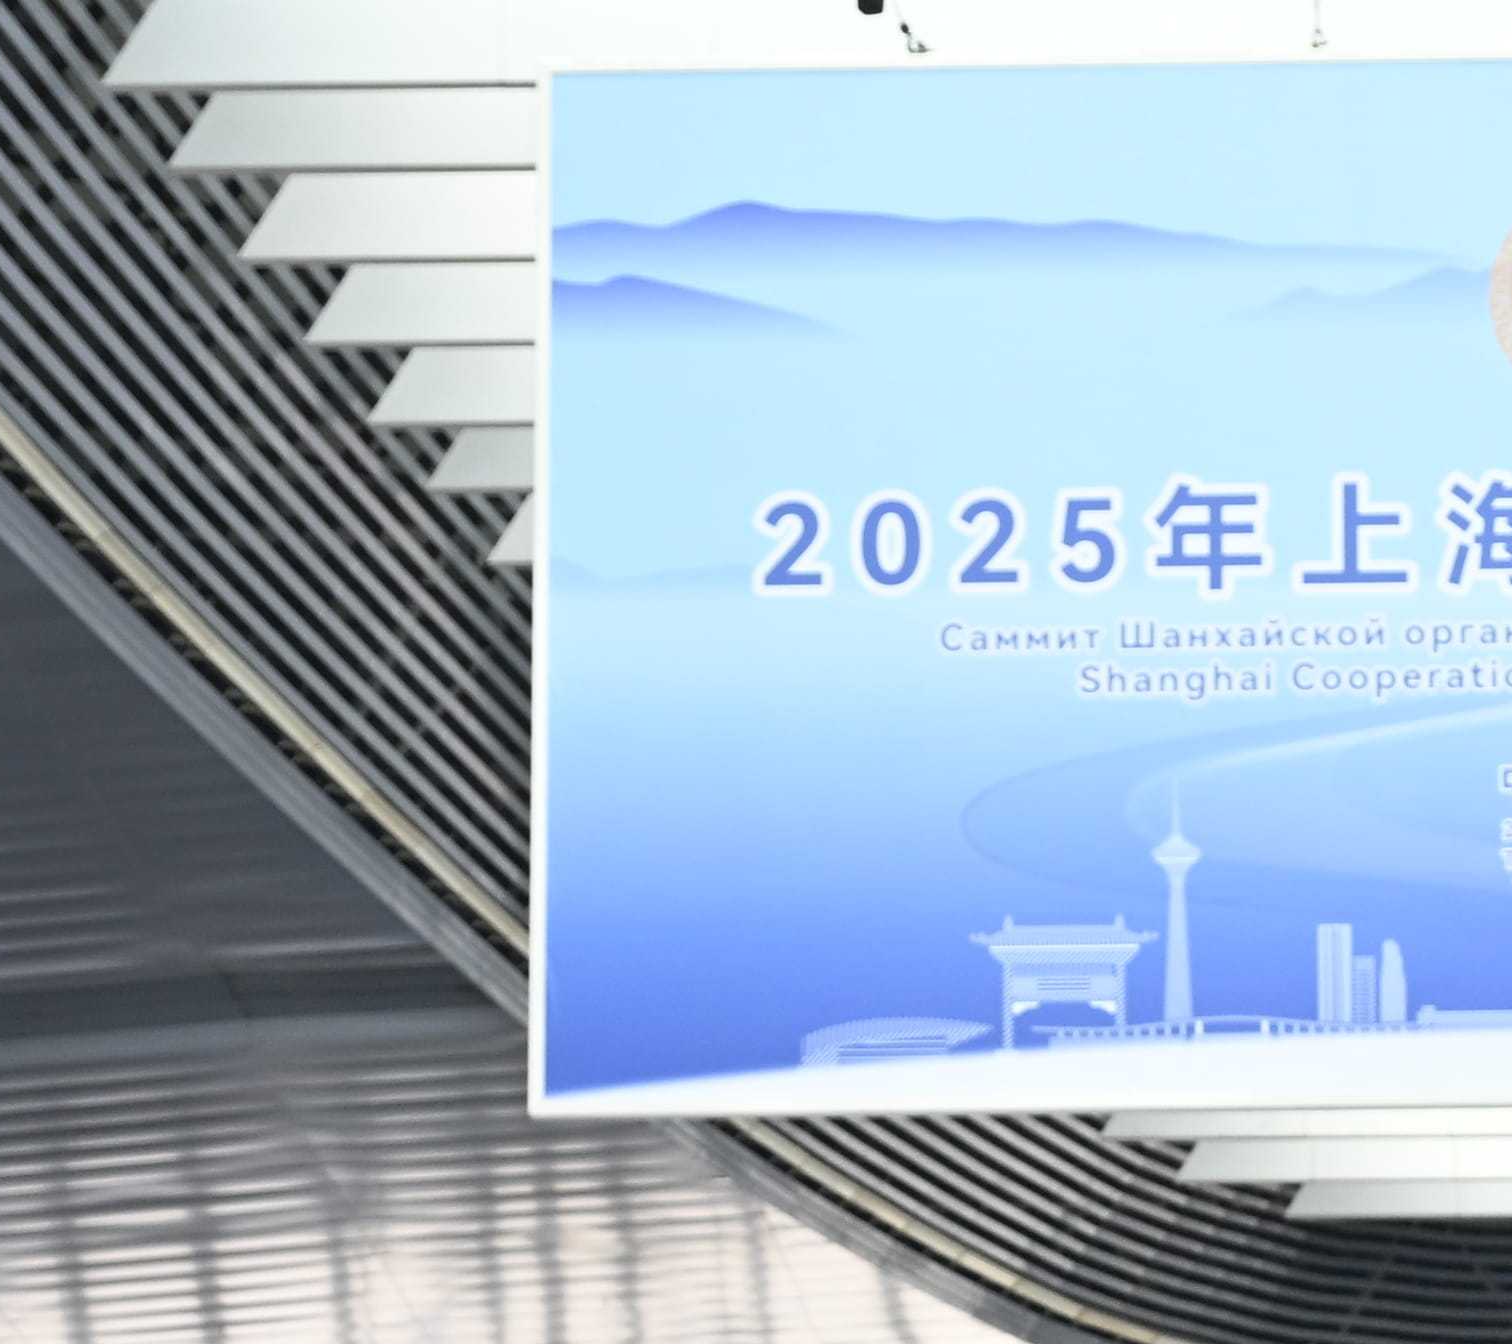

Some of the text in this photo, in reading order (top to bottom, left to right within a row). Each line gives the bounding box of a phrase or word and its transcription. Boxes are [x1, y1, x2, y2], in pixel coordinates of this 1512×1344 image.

[940, 624, 1101, 652] Саммит
[1120, 618, 1386, 650] Шанхайской
[1080, 662, 1272, 700] Shanghai
